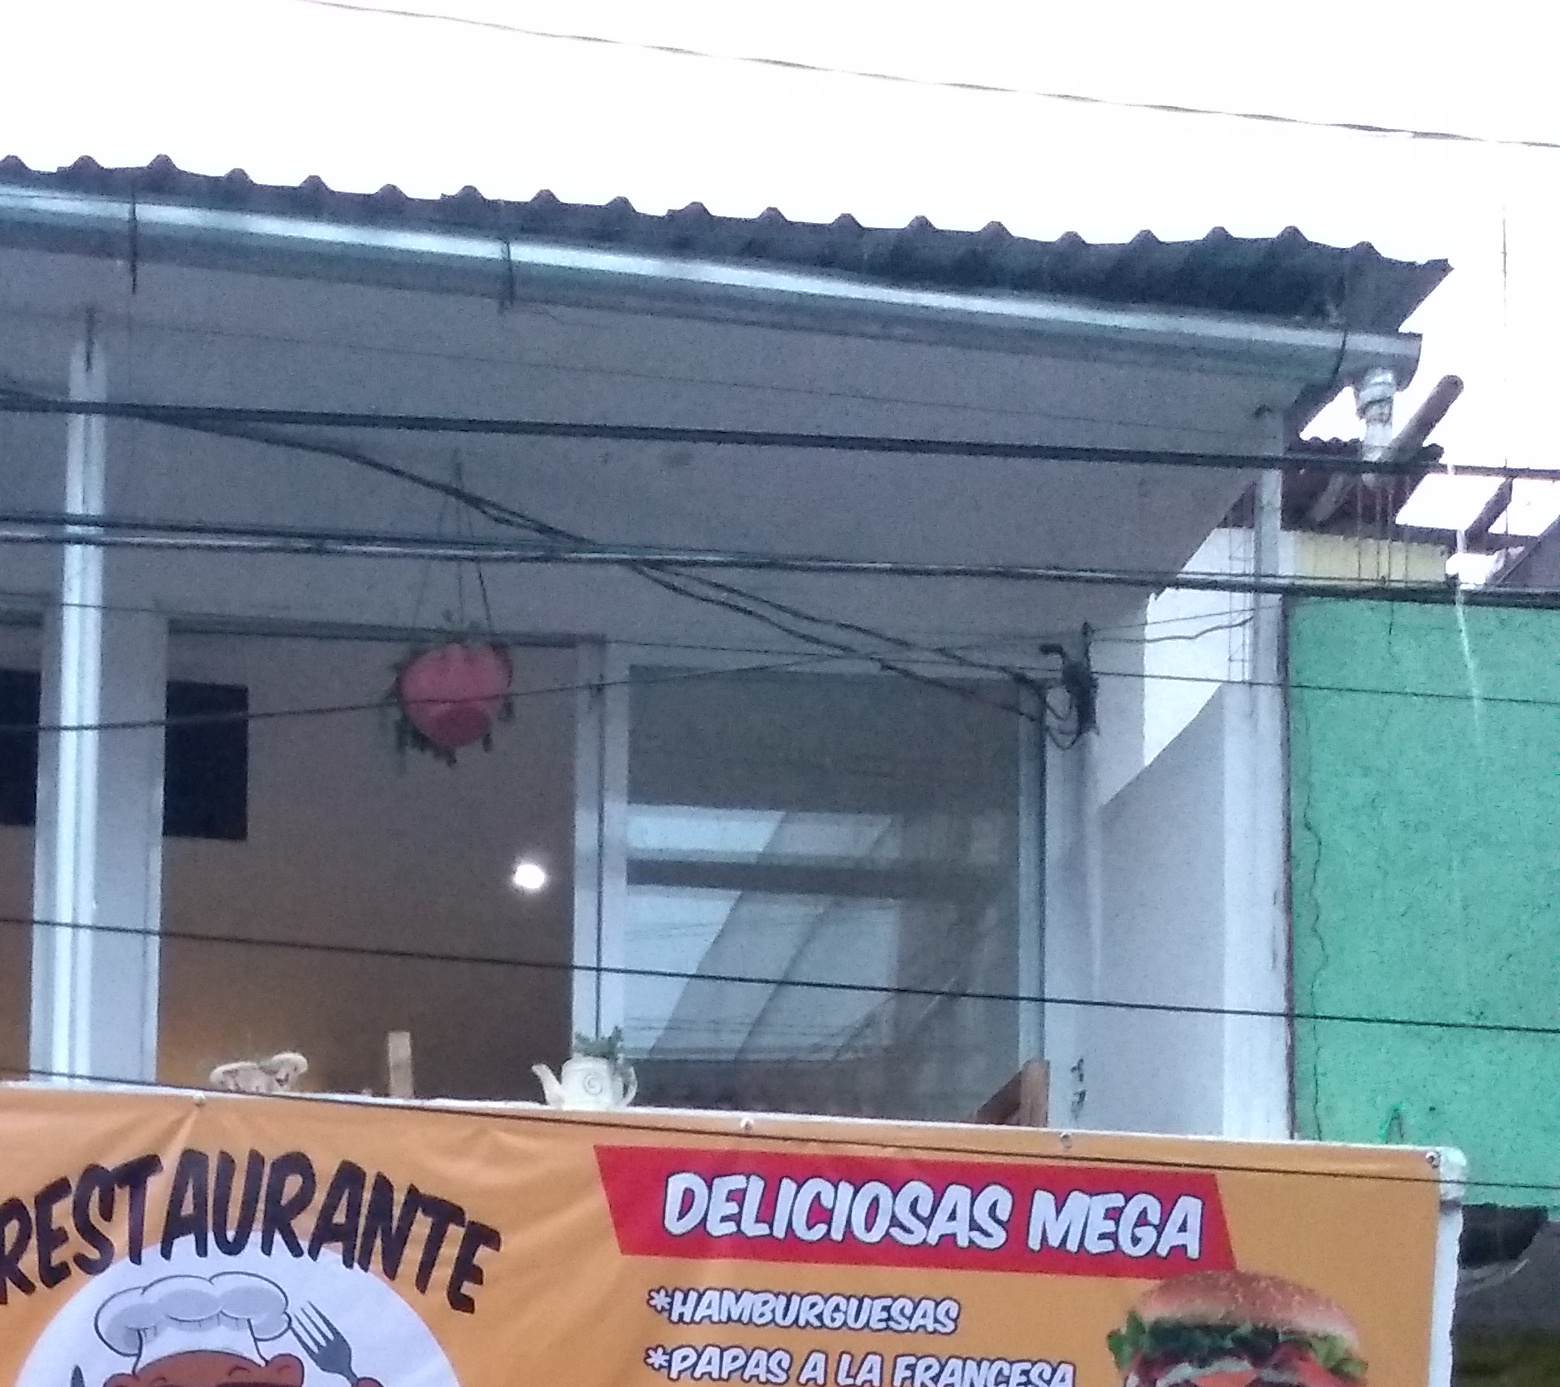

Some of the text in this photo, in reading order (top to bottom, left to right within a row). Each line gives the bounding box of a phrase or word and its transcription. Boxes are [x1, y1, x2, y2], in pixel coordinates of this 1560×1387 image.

[662, 1171, 1205, 1261] DELICIOSAS MEGA
[798, 1349, 828, 1387] A
